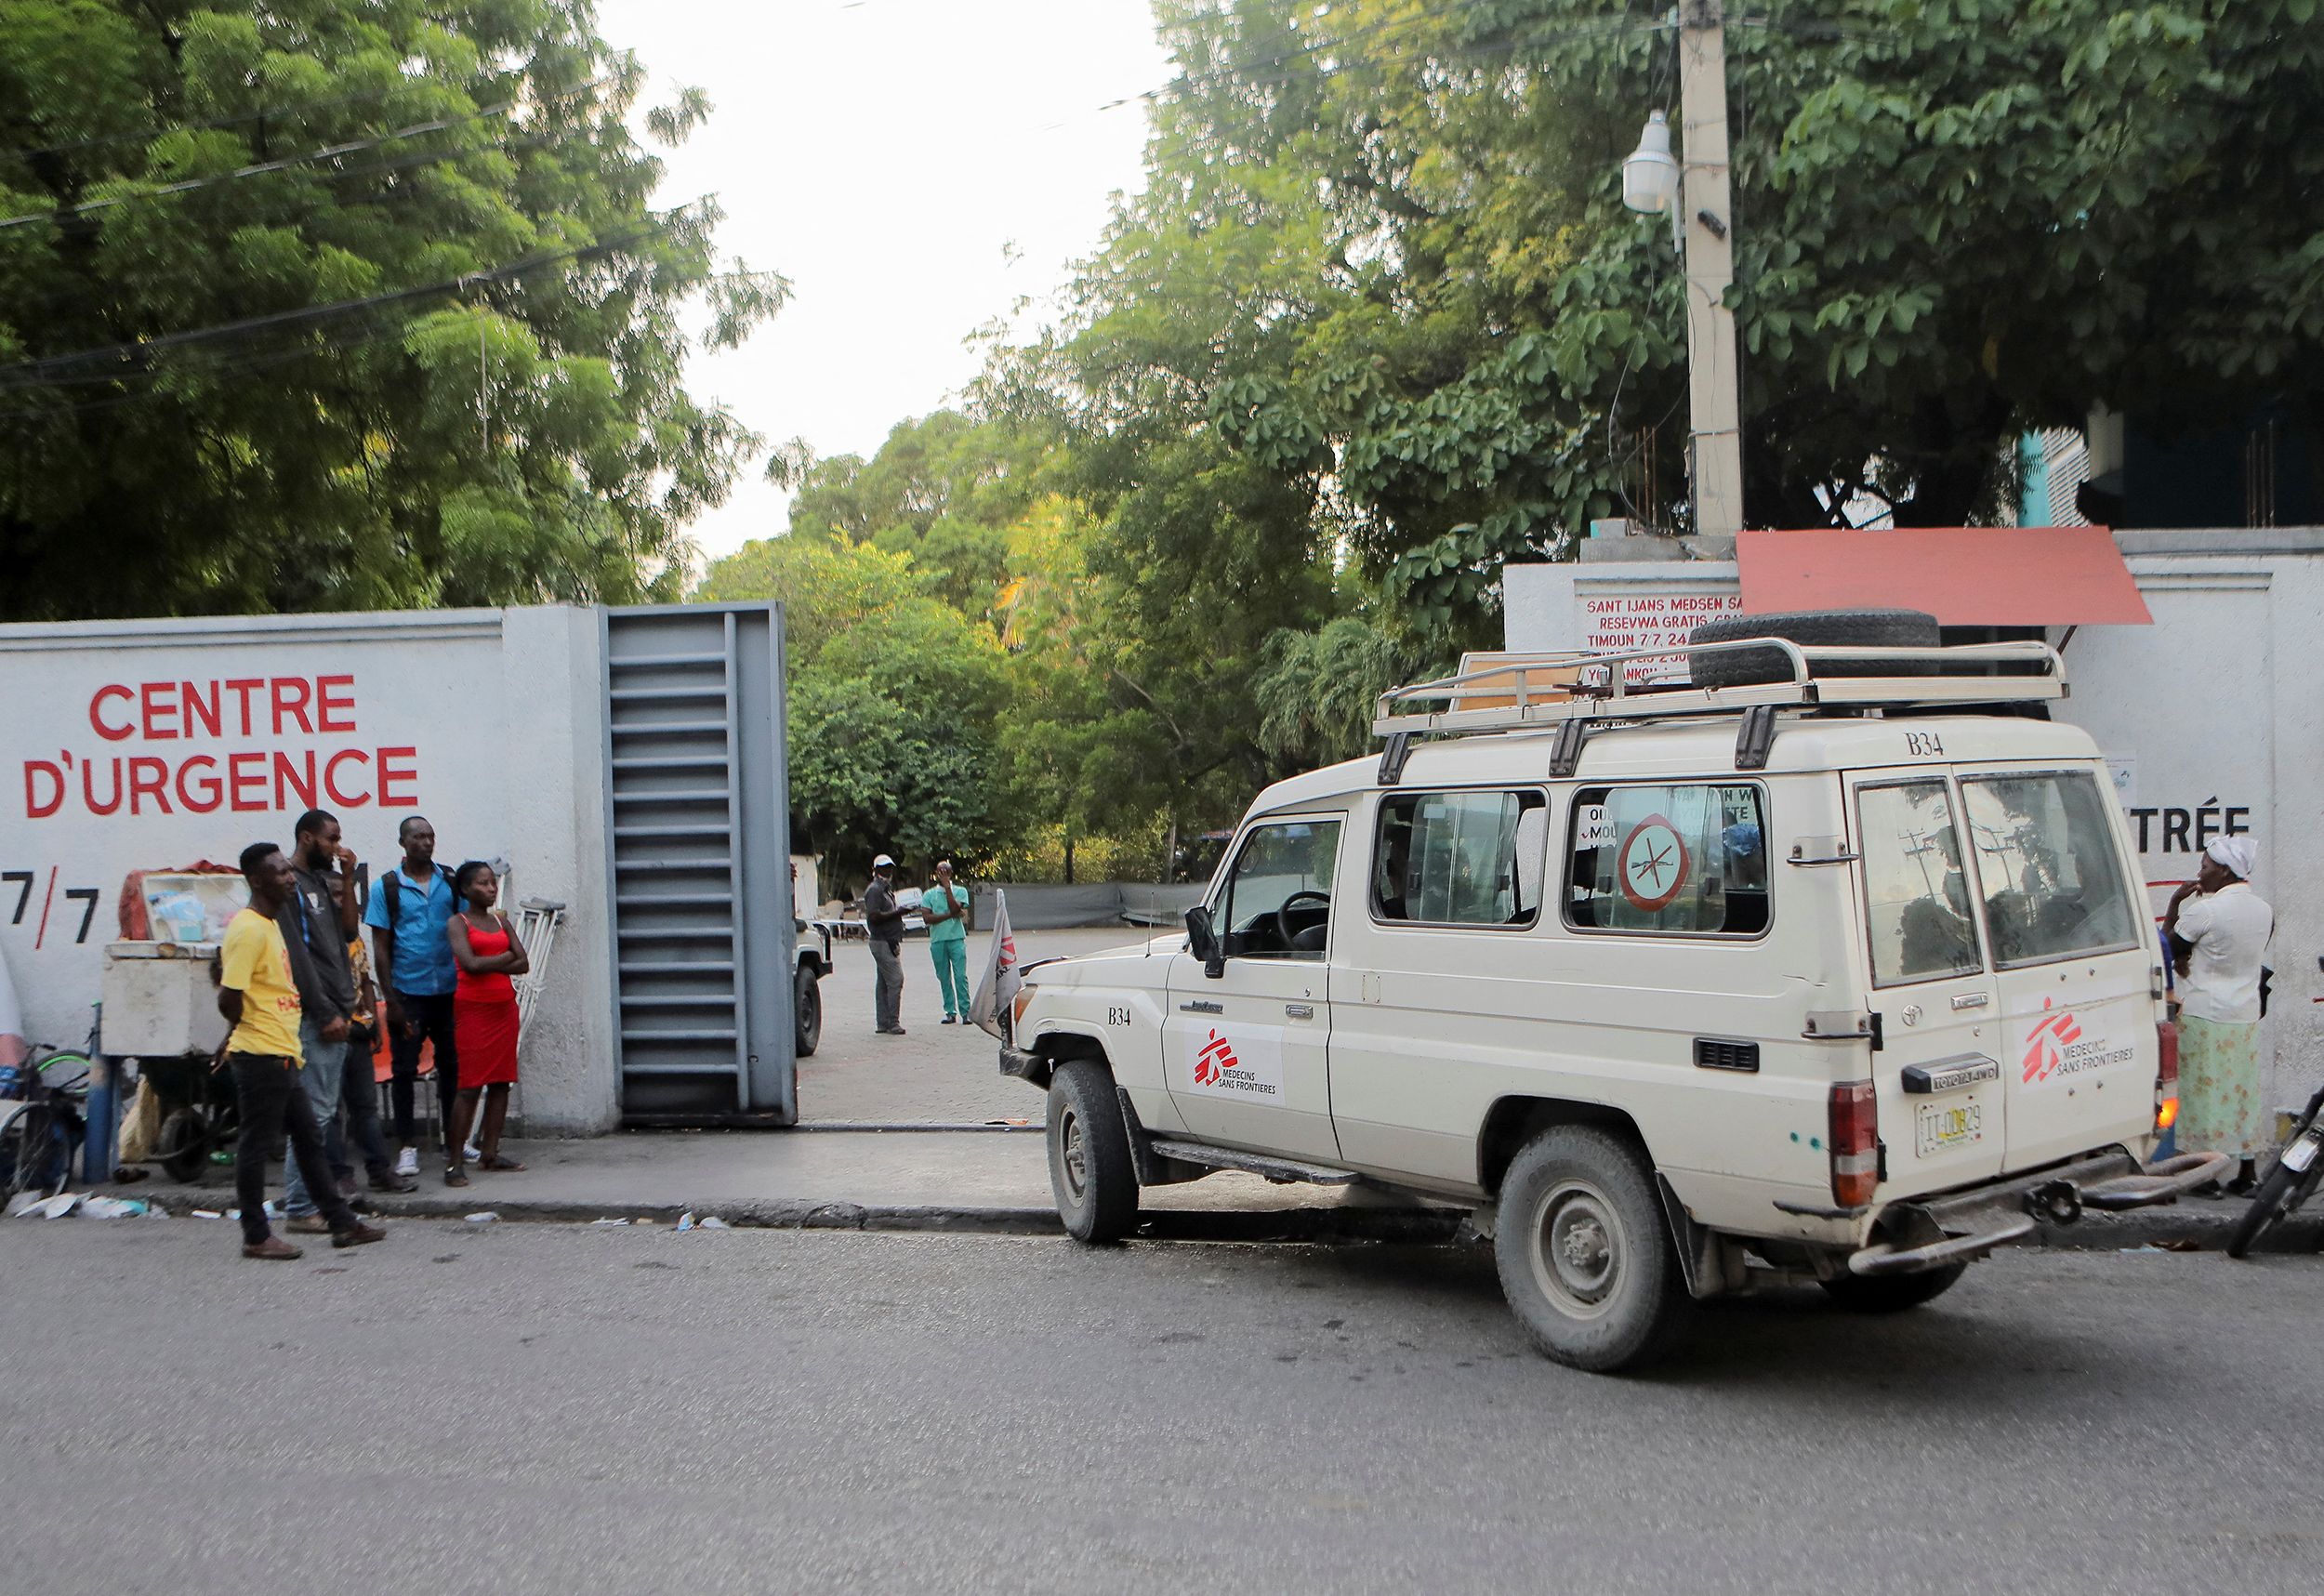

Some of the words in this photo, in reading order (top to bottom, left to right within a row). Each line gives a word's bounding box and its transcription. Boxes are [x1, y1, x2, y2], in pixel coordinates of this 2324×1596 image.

[1587, 600, 1622, 613] SANT
[1628, 599, 1665, 613] IJANS
[1670, 597, 1723, 611] MEDSEN
[1600, 616, 1658, 630] RESEVWA
[1588, 634, 1634, 647] TIMOUN
[88, 675, 357, 741] CENTRE
[1904, 732, 1944, 756] B34
[23, 746, 418, 819] D'URGENCE
[2122, 796, 2250, 853] TRÉE
[1, 865, 100, 951] 7/7
[1108, 1007, 1131, 1026] B34
[2056, 1060, 2080, 1076] SANS
[2082, 1048, 2134, 1071] FRONTIERES
[1222, 1068, 1255, 1081] MEDECINS
[1934, 1072, 1972, 1089] TOYOTA
[1218, 1078, 1235, 1088] SANS
[1235, 1081, 1276, 1095] FRONTIERES
